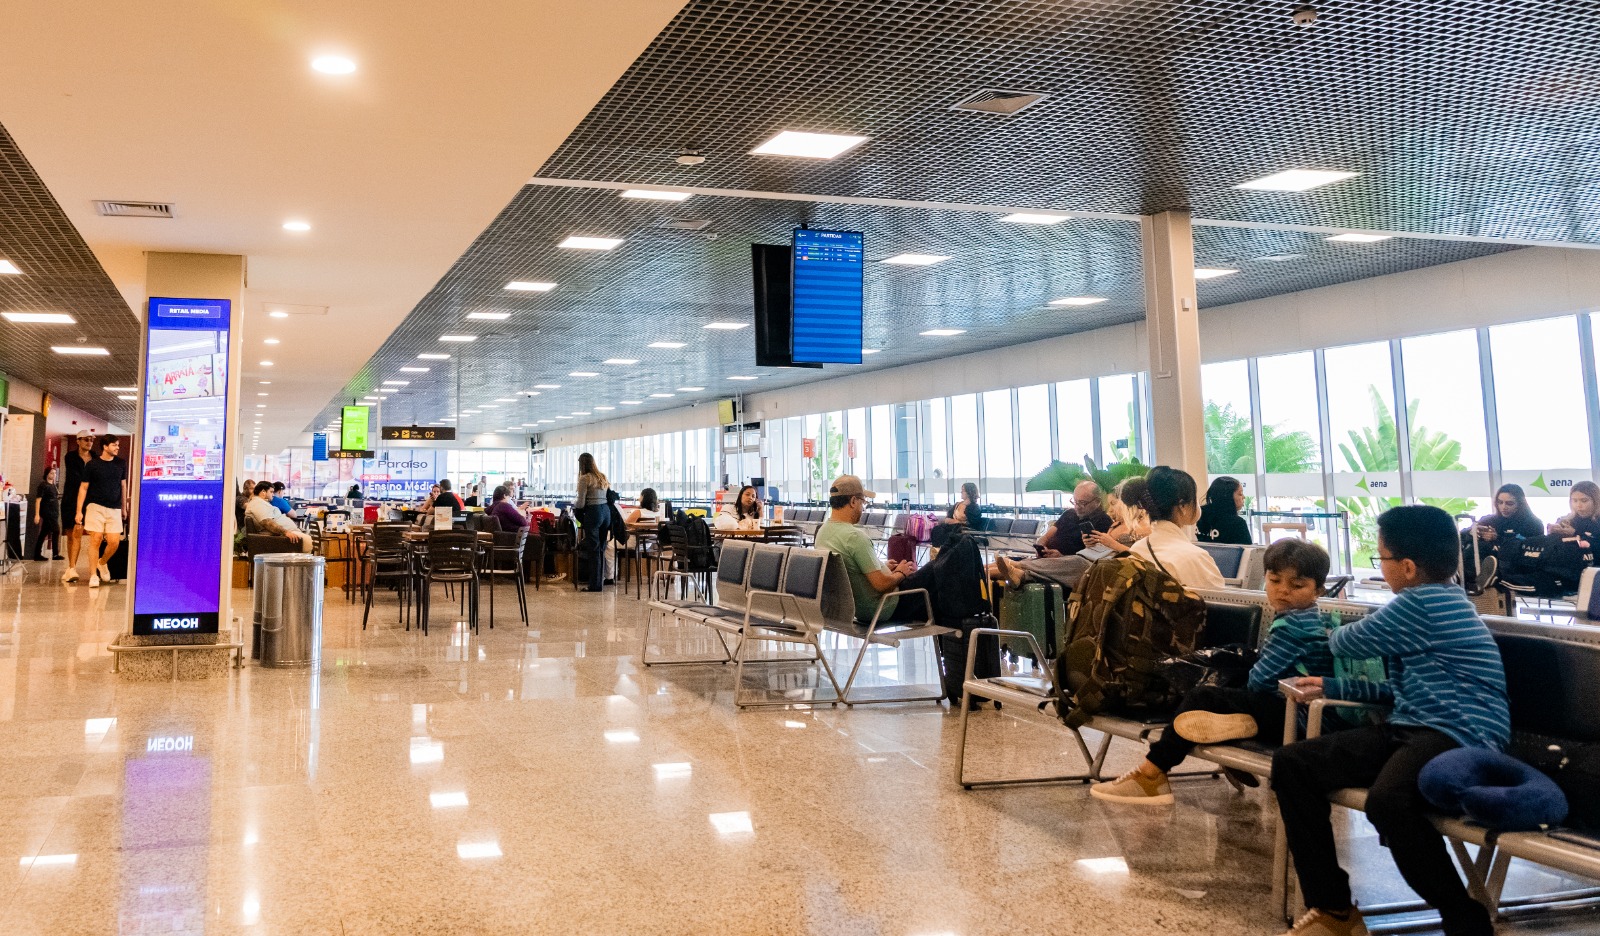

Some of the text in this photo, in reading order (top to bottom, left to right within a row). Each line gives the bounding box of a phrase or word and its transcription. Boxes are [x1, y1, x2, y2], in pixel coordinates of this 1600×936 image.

[369, 481, 402, 491] Ensino
[1549, 479, 1573, 487] aena
[153, 617, 199, 629] NEOOH
